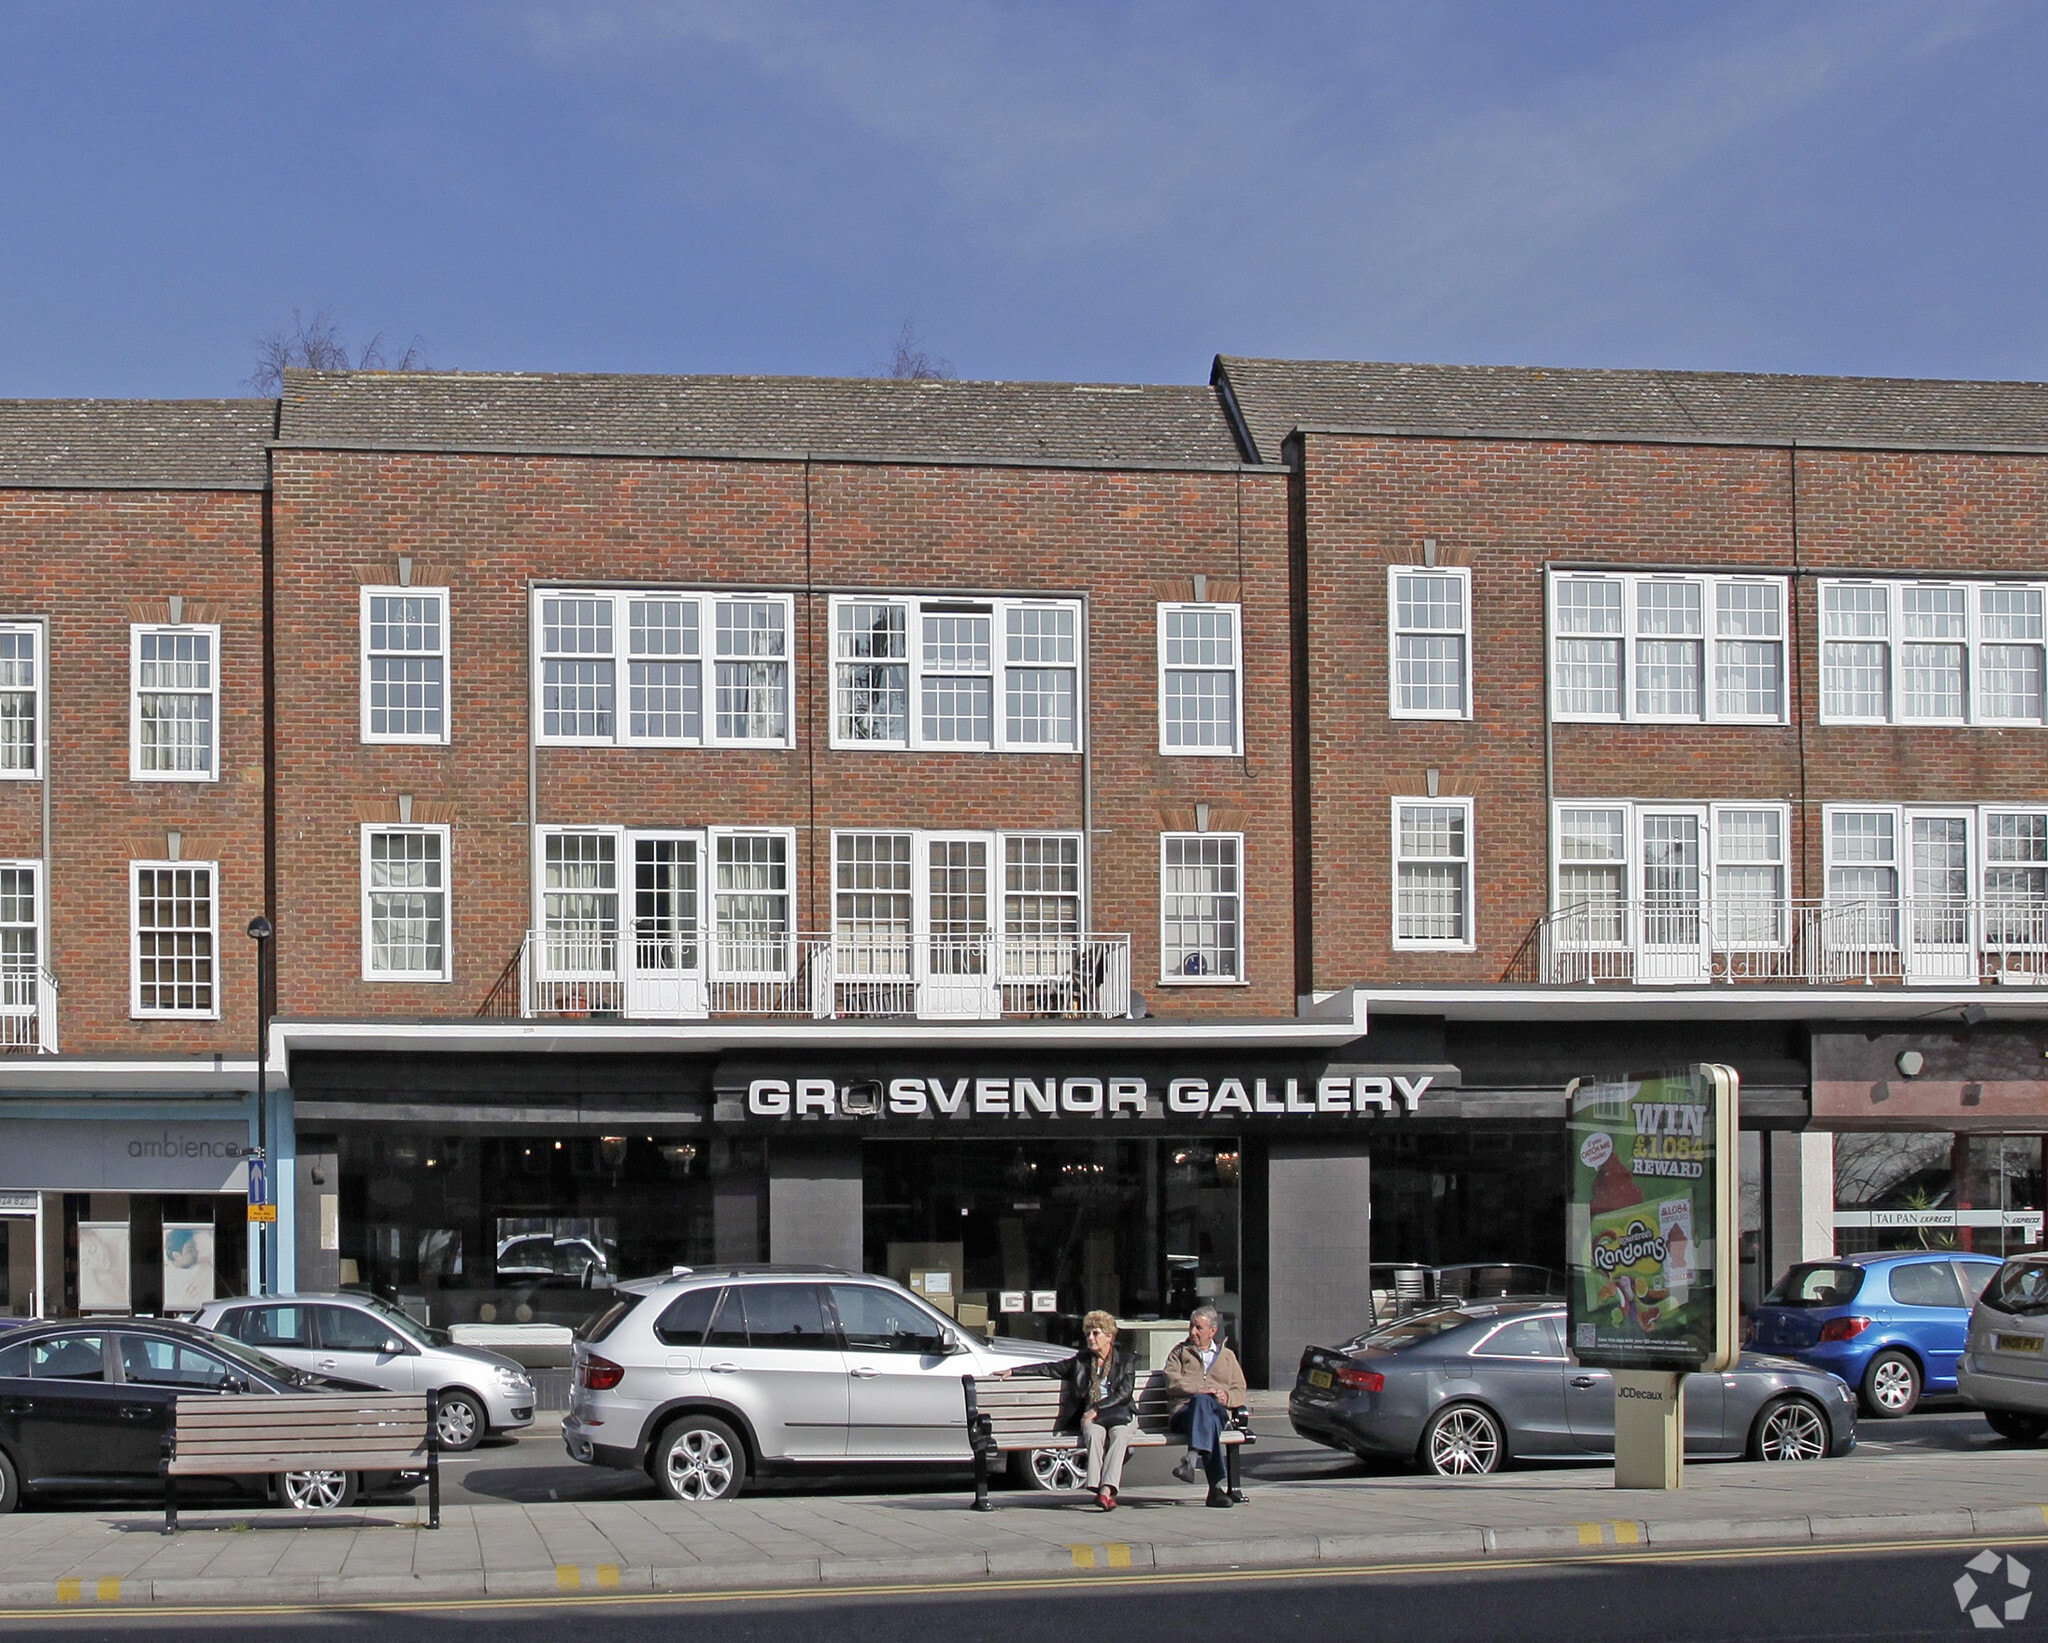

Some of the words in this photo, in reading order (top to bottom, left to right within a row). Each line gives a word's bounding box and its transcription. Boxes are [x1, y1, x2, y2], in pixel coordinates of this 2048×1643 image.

[1168, 1077, 1434, 1113] GALLERY
[1632, 1103, 1706, 1136] WIN
[128, 1133, 239, 1158] ambience
[1600, 1140, 1610, 1151] ME
[1632, 1158, 1703, 1178] REWARD
[1876, 1214, 1893, 1224] TAI
[1897, 1213, 1918, 1223] PAN
[1919, 1215, 1952, 1223] EXPRESS
[1594, 1238, 1667, 1270] Randoms
[1617, 1387, 1663, 1401] JCDecaux
